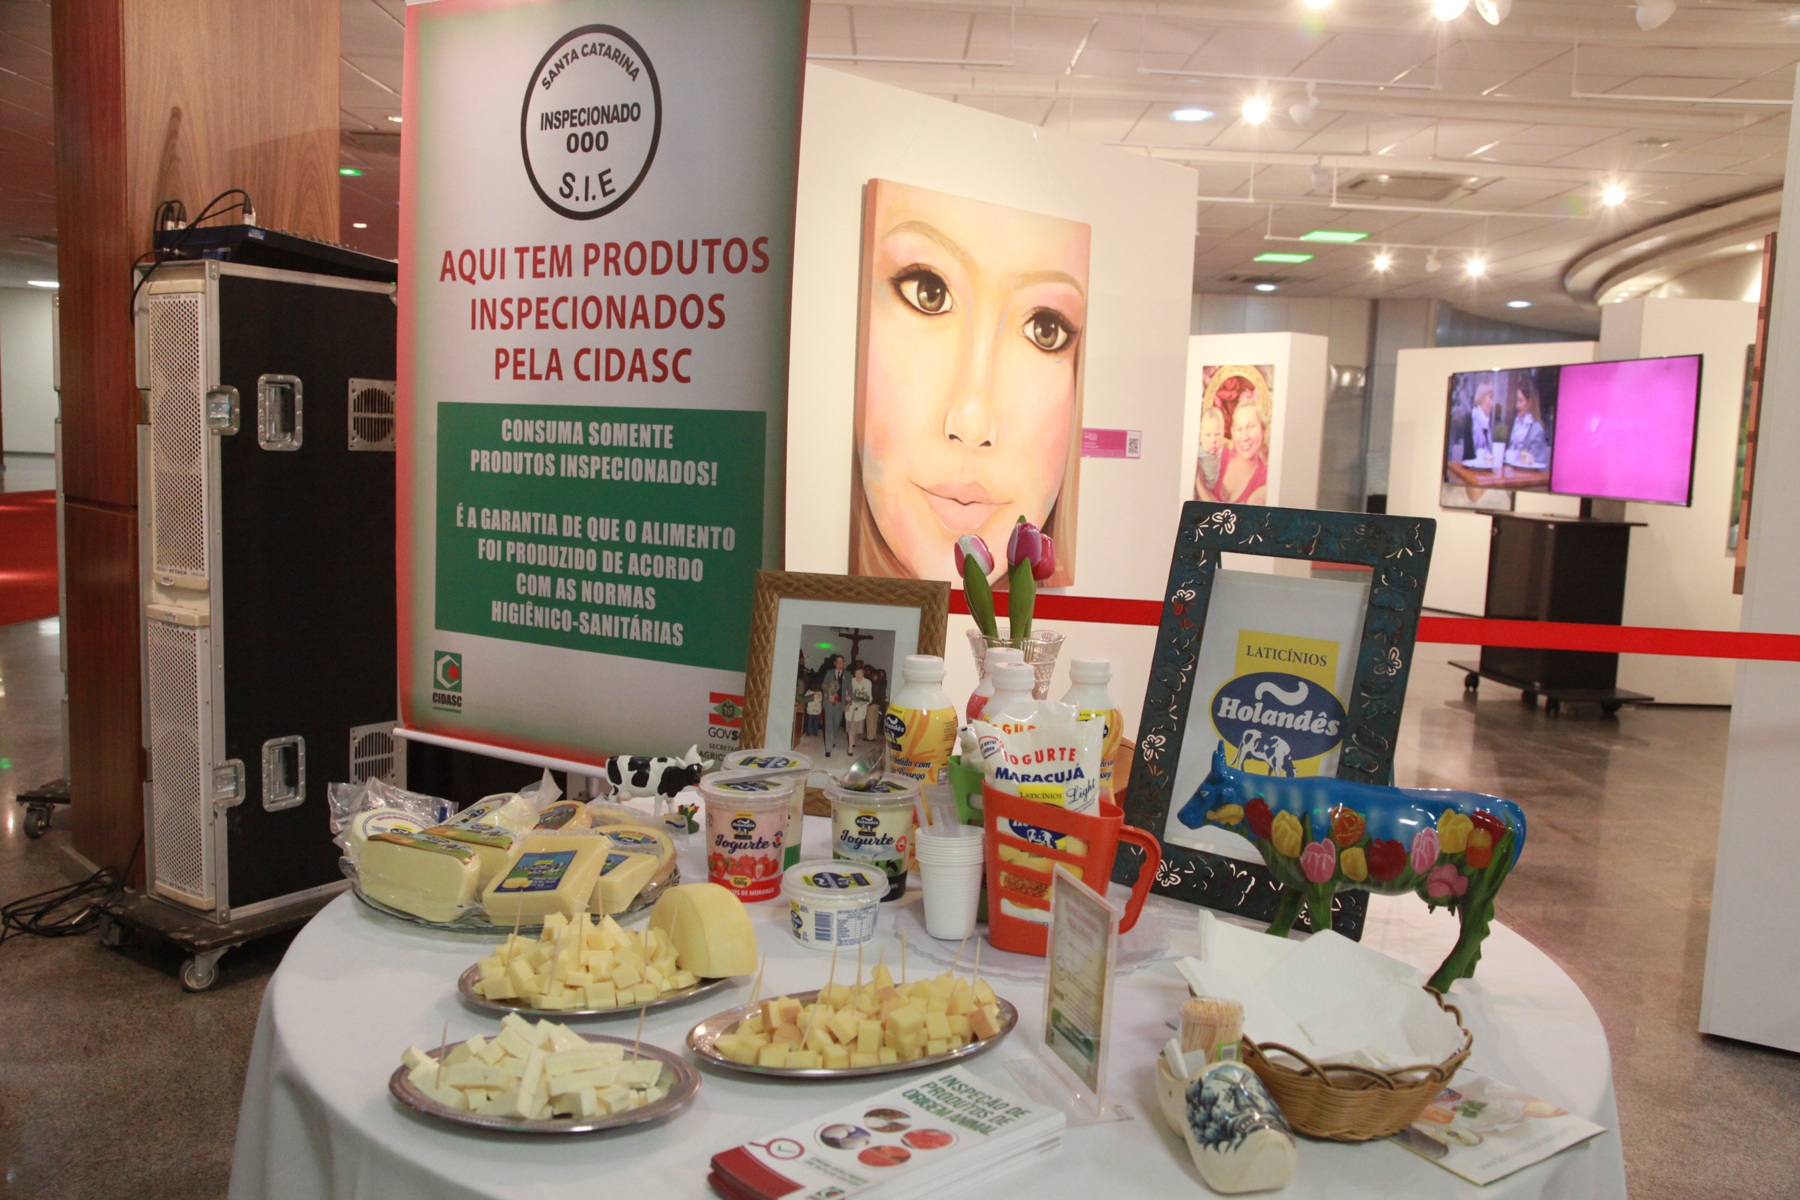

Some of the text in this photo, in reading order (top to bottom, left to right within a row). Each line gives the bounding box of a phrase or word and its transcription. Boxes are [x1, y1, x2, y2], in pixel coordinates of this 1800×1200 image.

[541, 42, 641, 90] SANTA CATARINA
[540, 102, 642, 131] INSPECIONADO
[558, 168, 616, 202] S.I.E
[440, 236, 770, 286] AQUI TEM PRODUTOS
[471, 293, 726, 330] INSPECIONADOS
[494, 347, 692, 384] PELA CIDASC
[502, 418, 674, 449] CONSUMA SOMENTE
[470, 450, 718, 486] PRODUTOS INSPECIONADOS!
[456, 502, 736, 552] É A GARANTIA DE QUE O ALIMENTO
[478, 538, 704, 583] FOI PRODUZIDO DE ACORDO
[516, 572, 656, 611] COM AS NORMAS
[491, 600, 684, 647] HIGIÊNICO-SANITÁRIAS
[1246, 644, 1328, 667] LATICÍNIOS
[432, 692, 462, 708] CIDASC
[1217, 697, 1340, 736] Holandês
[708, 726, 740, 741] GOVS
[995, 763, 1084, 783] MARACUJÁ
[1004, 747, 1076, 765] IOGURTE
[1020, 791, 1062, 799] LATICÍNIOS
[1066, 778, 1095, 804] Light
[749, 887, 774, 896] MORANGO
[902, 1088, 998, 1136] ORIGEM ANIMAL
[920, 1082, 1016, 1127] PRODUTOS DE
[939, 1074, 1032, 1118] INSPEÇÃO DE
